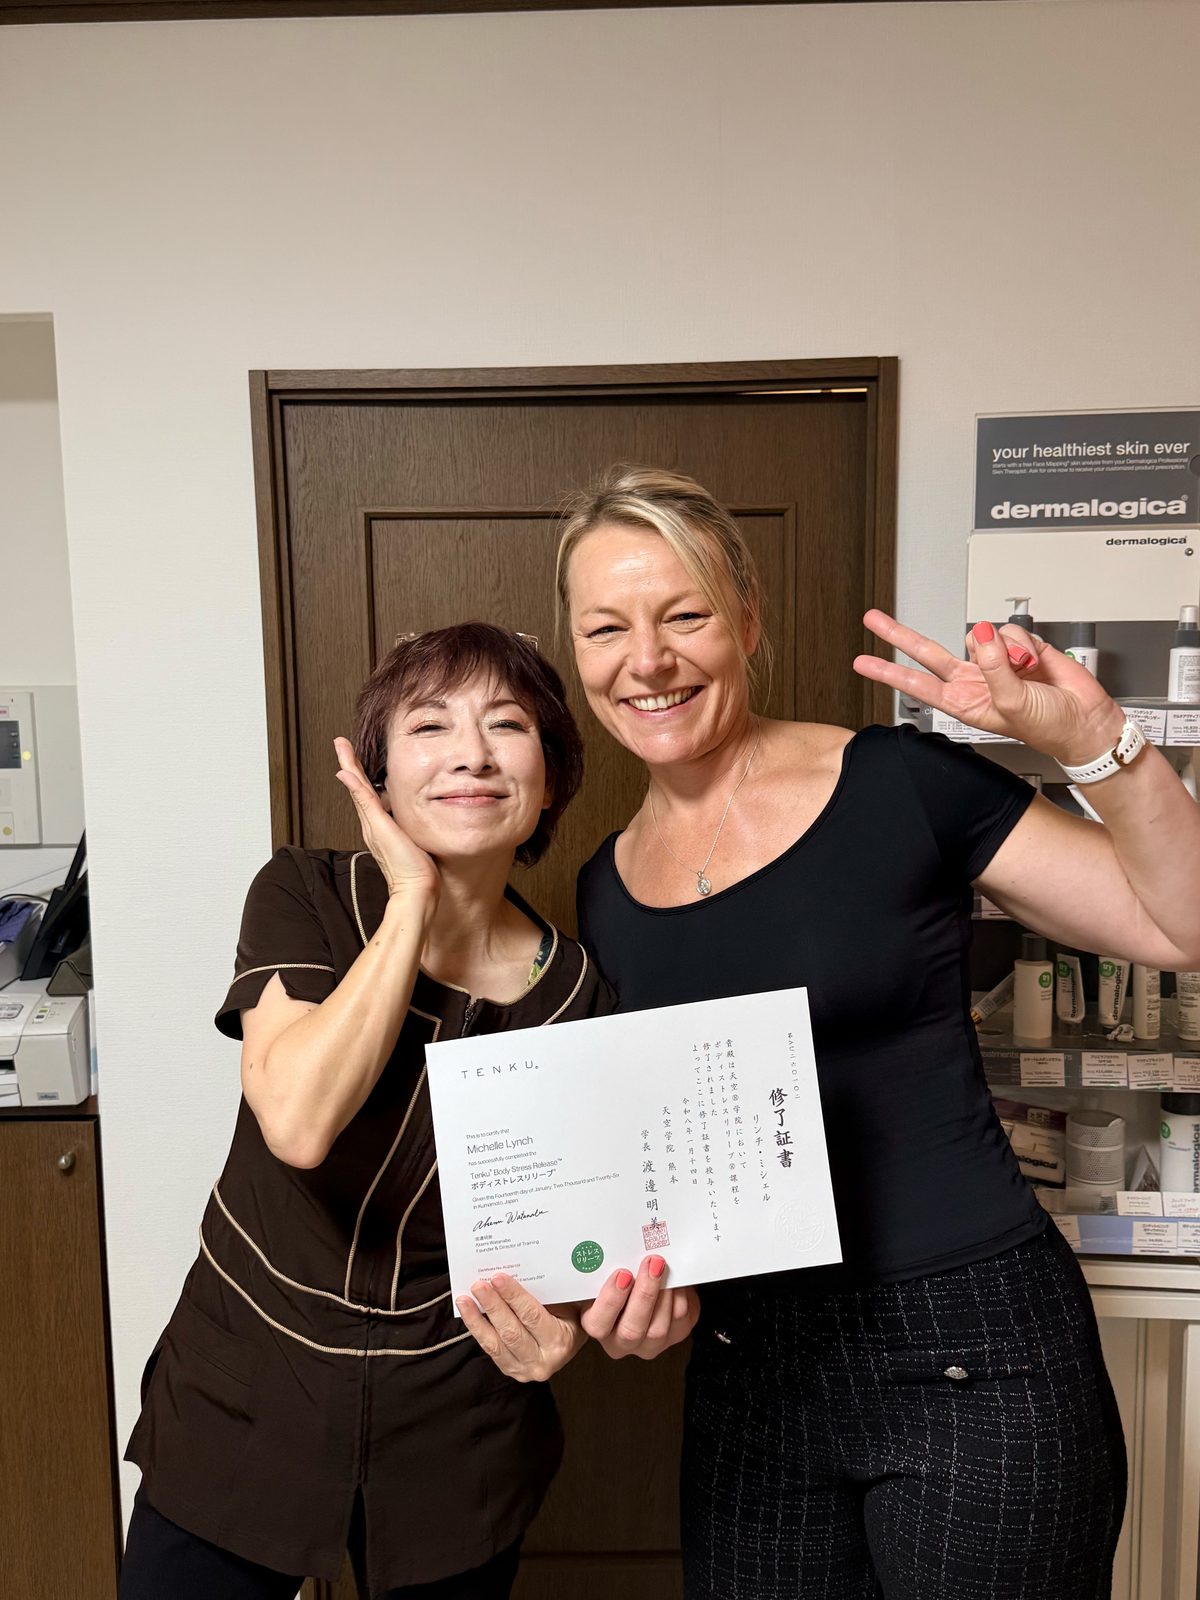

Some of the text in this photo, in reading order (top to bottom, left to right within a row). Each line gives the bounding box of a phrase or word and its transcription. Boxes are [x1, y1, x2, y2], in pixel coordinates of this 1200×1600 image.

[992, 441, 1190, 462] your healthiest skin ever
[1112, 965, 1122, 1021] dermalogica
[703, 1042, 718, 1116] 修了されました
[768, 1087, 794, 1169] 修了証書
[467, 1136, 534, 1155] Michelle Lynch
[641, 1129, 652, 1152] 学長
[494, 1166, 510, 1177] Body
[511, 1162, 532, 1173] Stress
